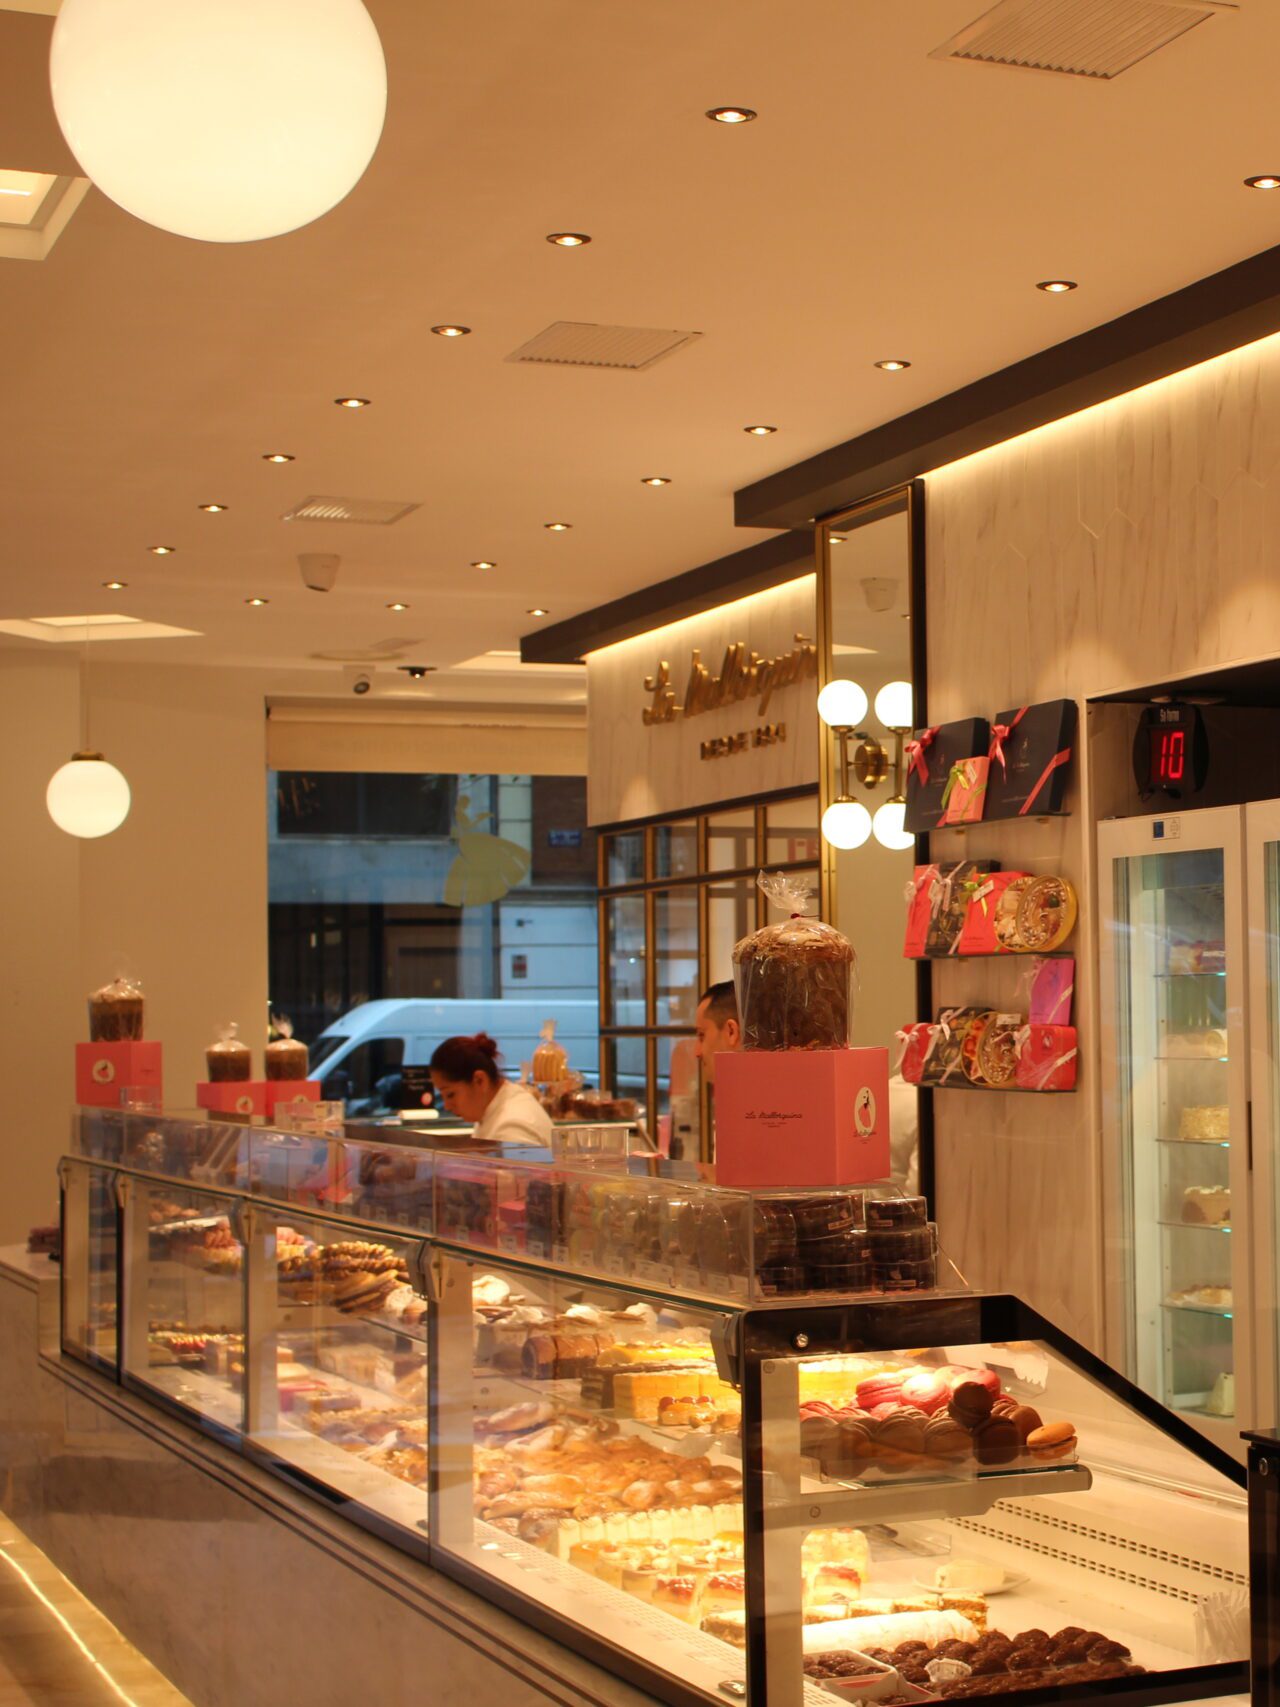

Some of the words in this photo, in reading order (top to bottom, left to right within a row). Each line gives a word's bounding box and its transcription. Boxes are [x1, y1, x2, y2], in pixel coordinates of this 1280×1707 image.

[642, 661, 684, 726] La
[684, 633, 817, 718] Mallorquin
[1160, 732, 1184, 778] 10
